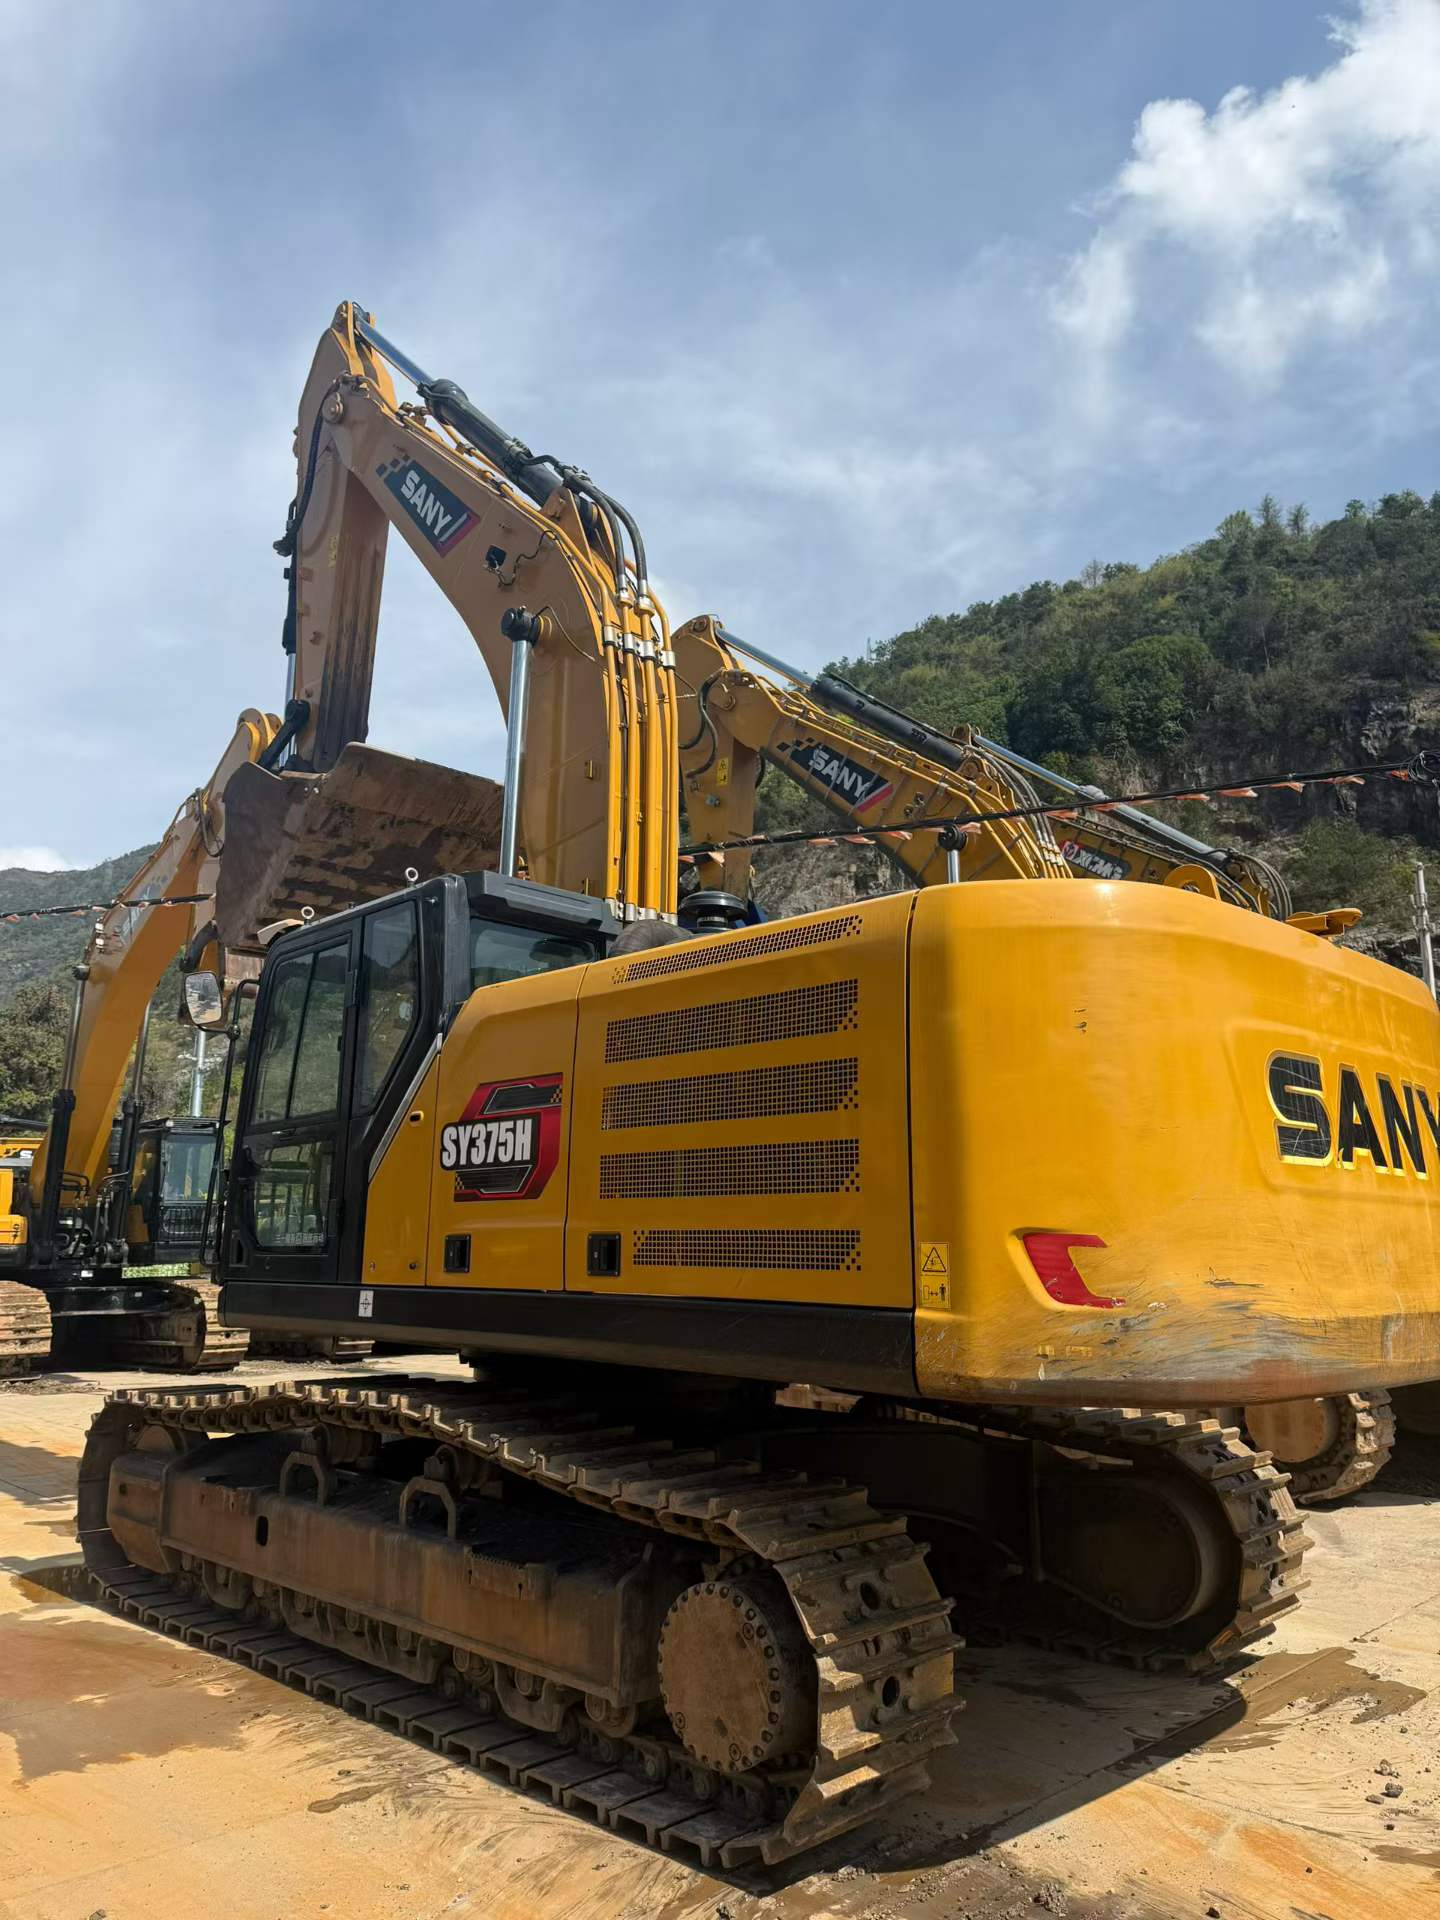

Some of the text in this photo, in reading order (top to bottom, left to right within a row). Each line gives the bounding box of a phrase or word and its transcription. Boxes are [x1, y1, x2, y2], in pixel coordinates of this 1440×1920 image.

[400, 469, 453, 537] SANY
[808, 748, 873, 798] SANY
[442, 1118, 532, 1168] SY375H
